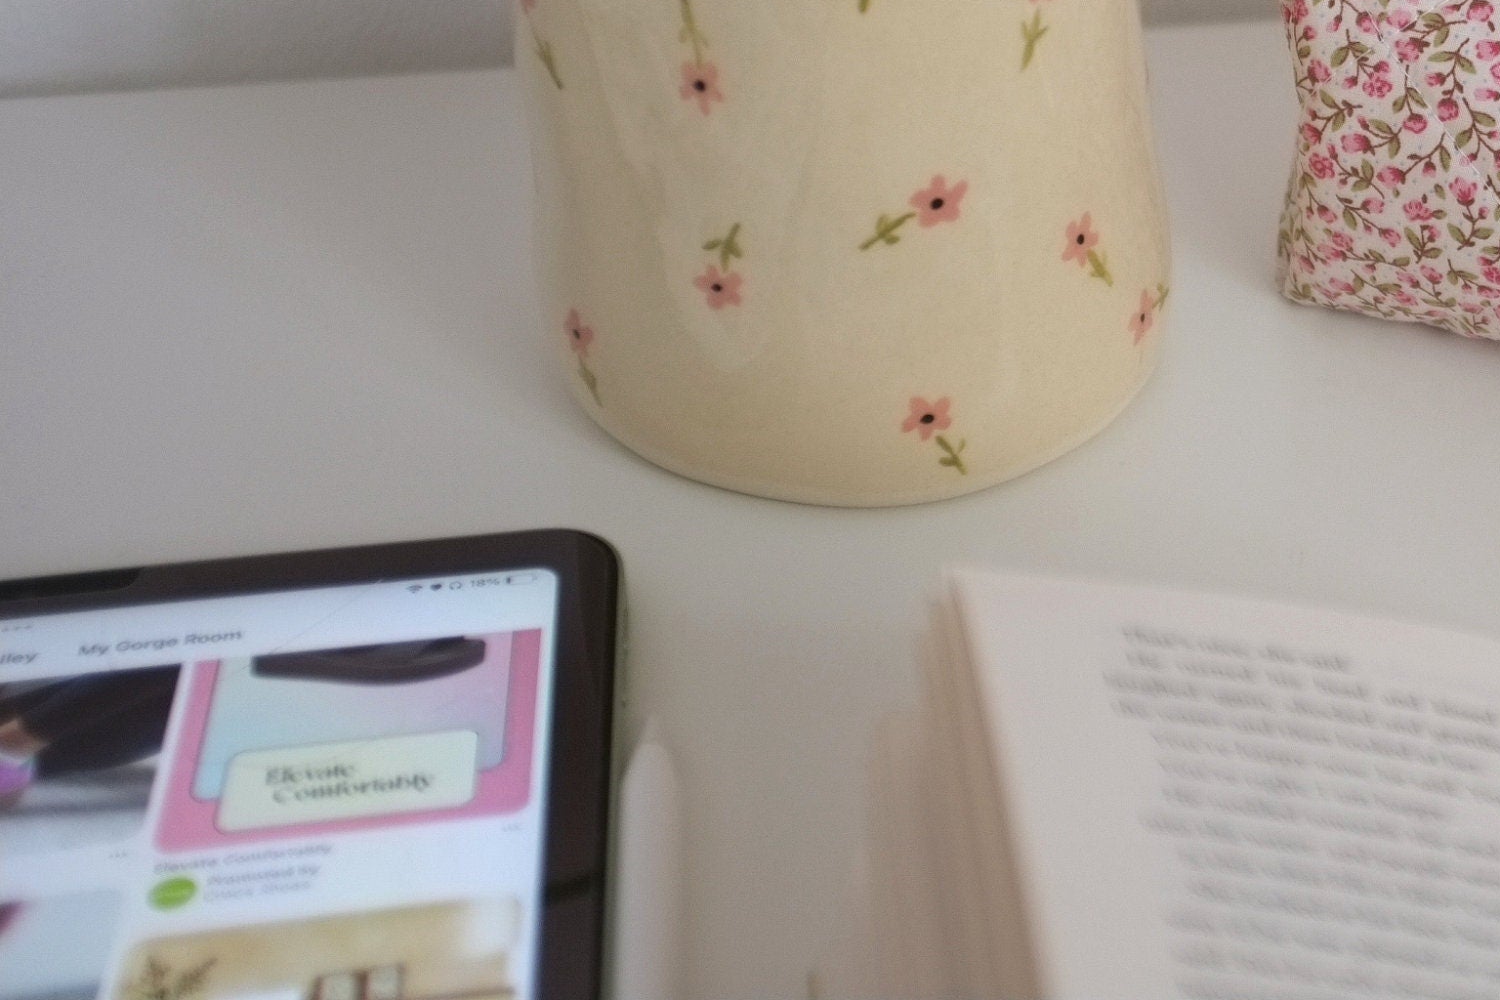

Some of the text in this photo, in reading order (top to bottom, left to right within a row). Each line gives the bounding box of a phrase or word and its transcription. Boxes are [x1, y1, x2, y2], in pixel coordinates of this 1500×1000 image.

[470, 578, 500, 587] 18%
[78, 629, 243, 657] My Gorge Room
[265, 764, 354, 785] Elevate
[272, 773, 434, 803] Comfortably
